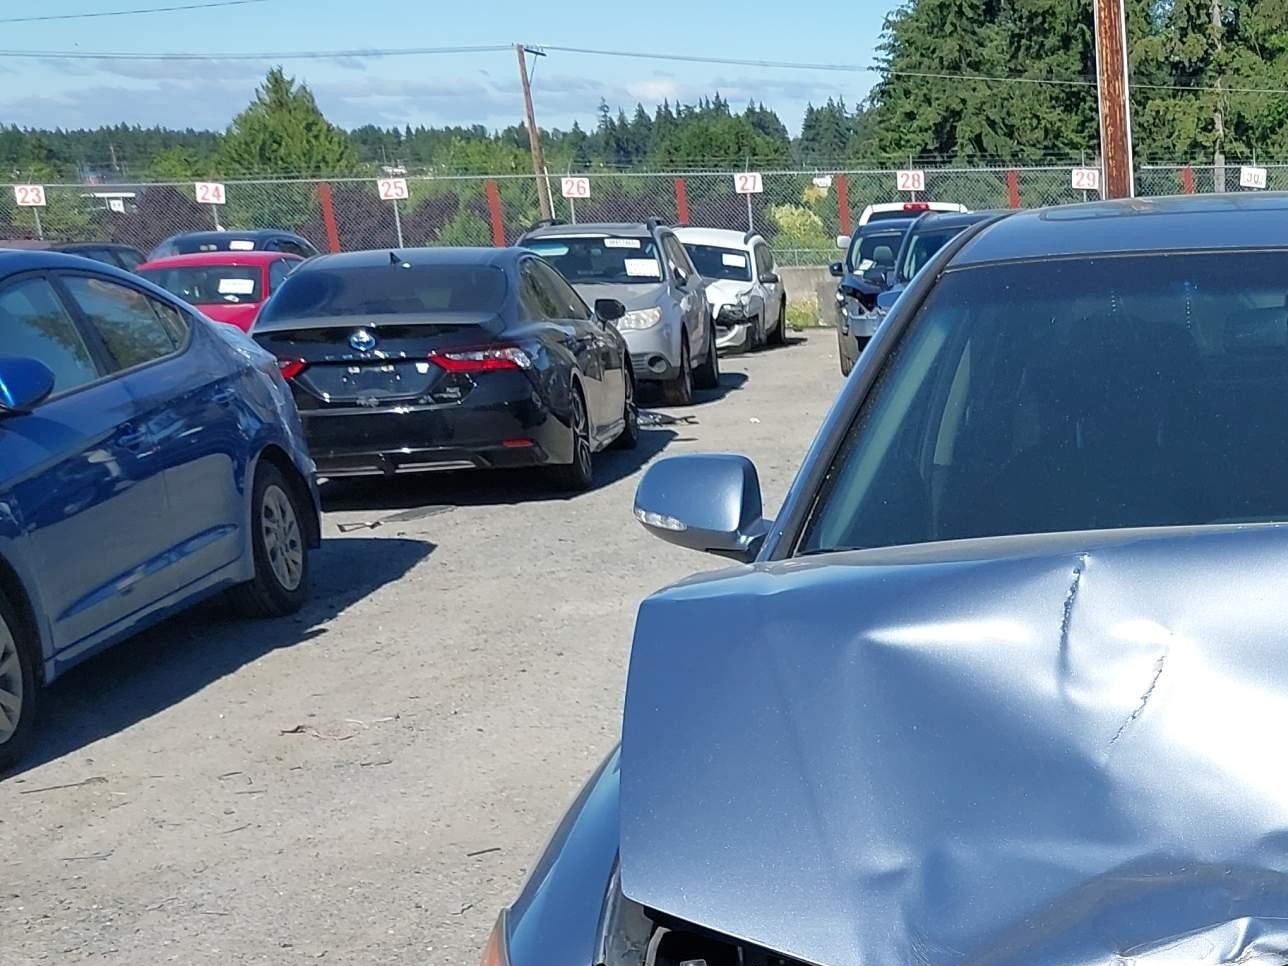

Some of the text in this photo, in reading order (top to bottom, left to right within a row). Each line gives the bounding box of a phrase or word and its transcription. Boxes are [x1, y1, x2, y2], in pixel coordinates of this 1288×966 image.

[565, 179, 587, 196] 26
[738, 175, 757, 192] 27
[900, 172, 921, 190] 28
[1075, 170, 1096, 188] 29
[18, 186, 43, 205] 23
[199, 185, 222, 202] 24
[381, 180, 405, 198] 25
